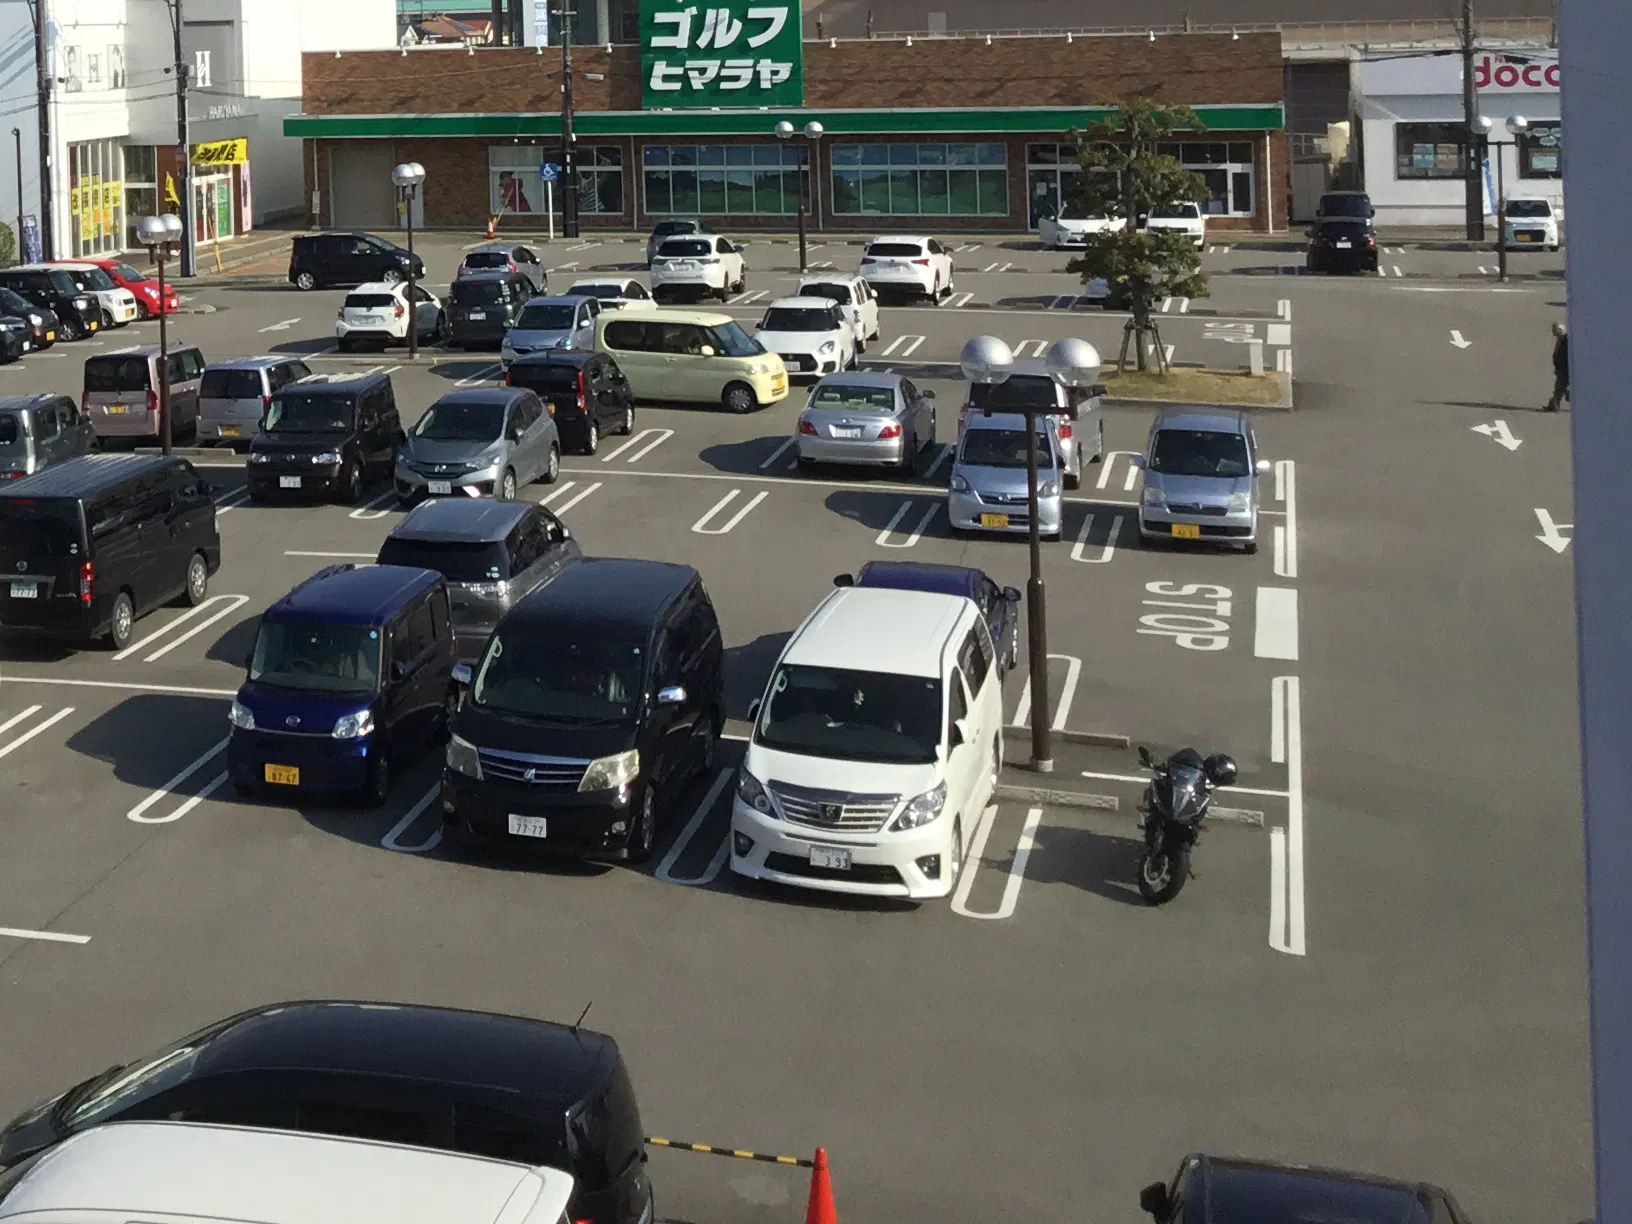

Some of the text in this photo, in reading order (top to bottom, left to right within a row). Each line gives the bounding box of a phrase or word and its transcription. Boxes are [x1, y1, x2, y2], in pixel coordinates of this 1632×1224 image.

[650, 6, 789, 49] ゴルフ
[649, 58, 793, 91] ヒマラヤ
[1135, 580, 1233, 652] STOP
[515, 821, 544, 837] 77-77
